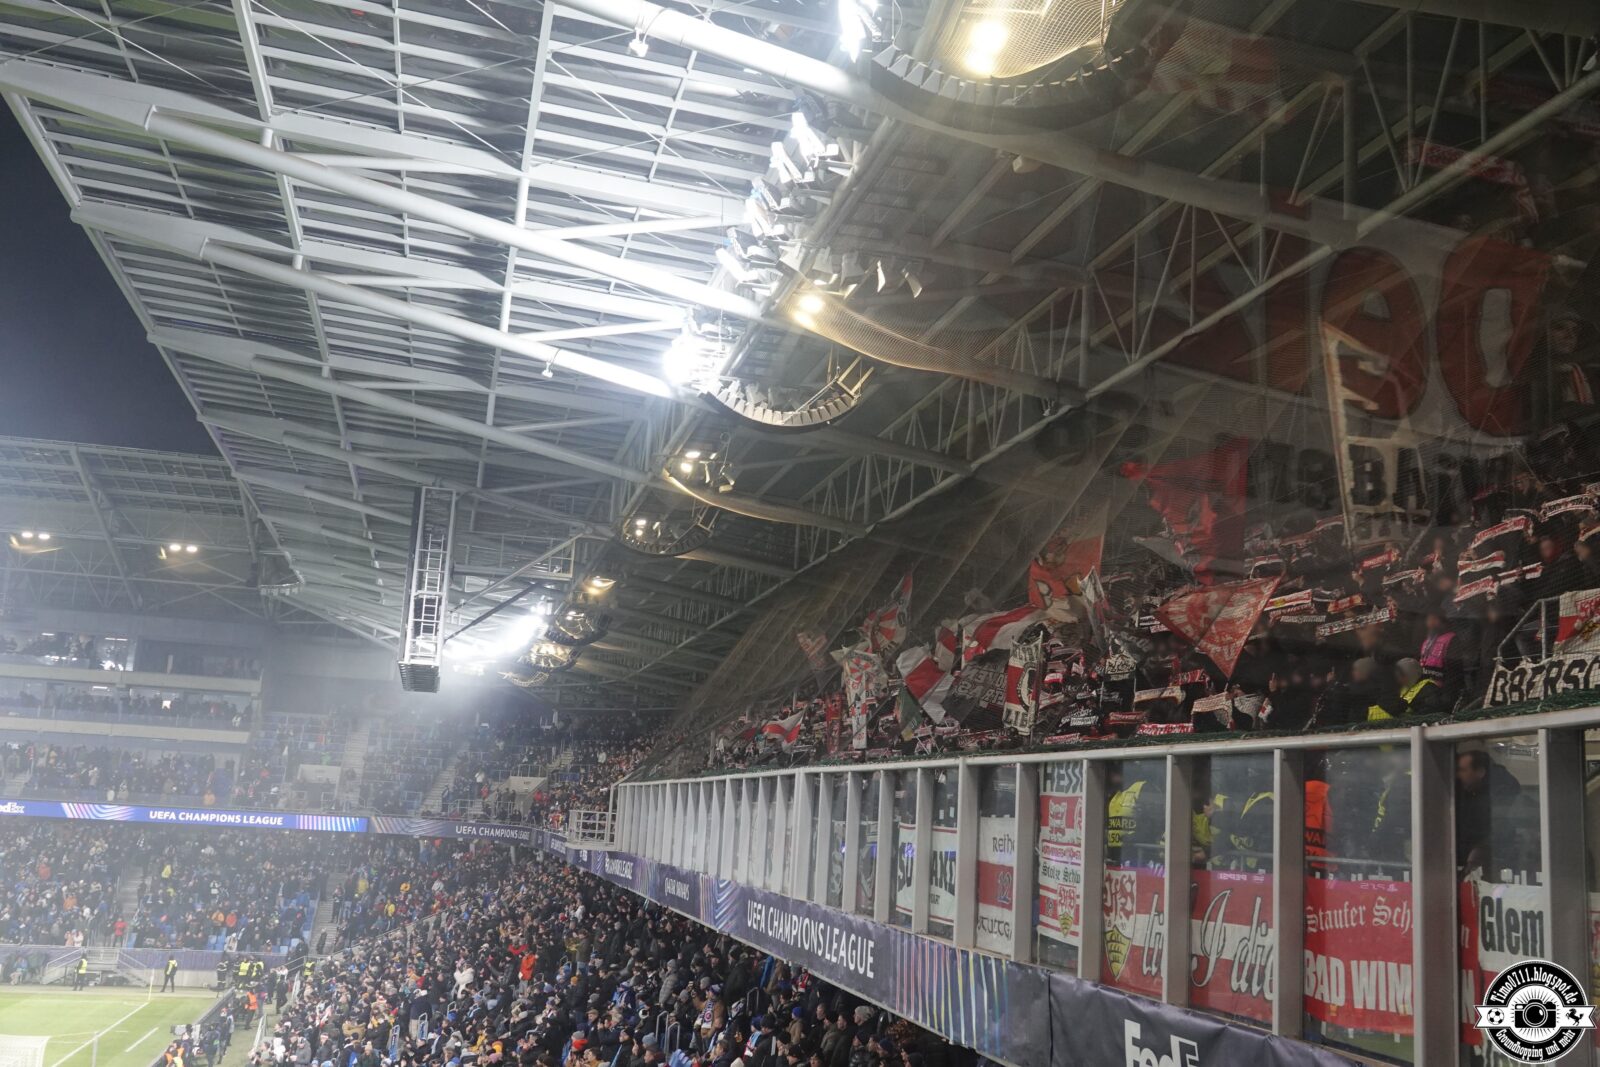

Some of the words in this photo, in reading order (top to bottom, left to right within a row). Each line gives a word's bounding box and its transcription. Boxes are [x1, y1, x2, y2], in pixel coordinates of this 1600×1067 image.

[1043, 761, 1084, 793] HESS
[149, 811, 176, 820] UEFA
[178, 812, 241, 823] CHAMPIONS
[243, 815, 283, 825] LEAGUE
[455, 825, 477, 835] UEFA
[478, 827, 518, 839] CHAMPIONS
[1305, 900, 1367, 934] Staufer
[1372, 895, 1414, 936] Sch
[1480, 895, 1545, 959] Glem
[747, 900, 766, 934] UEFA
[767, 906, 825, 957] CHAMPIONS
[825, 925, 875, 979] LEAGUE
[1303, 949, 1346, 1007] BAD
